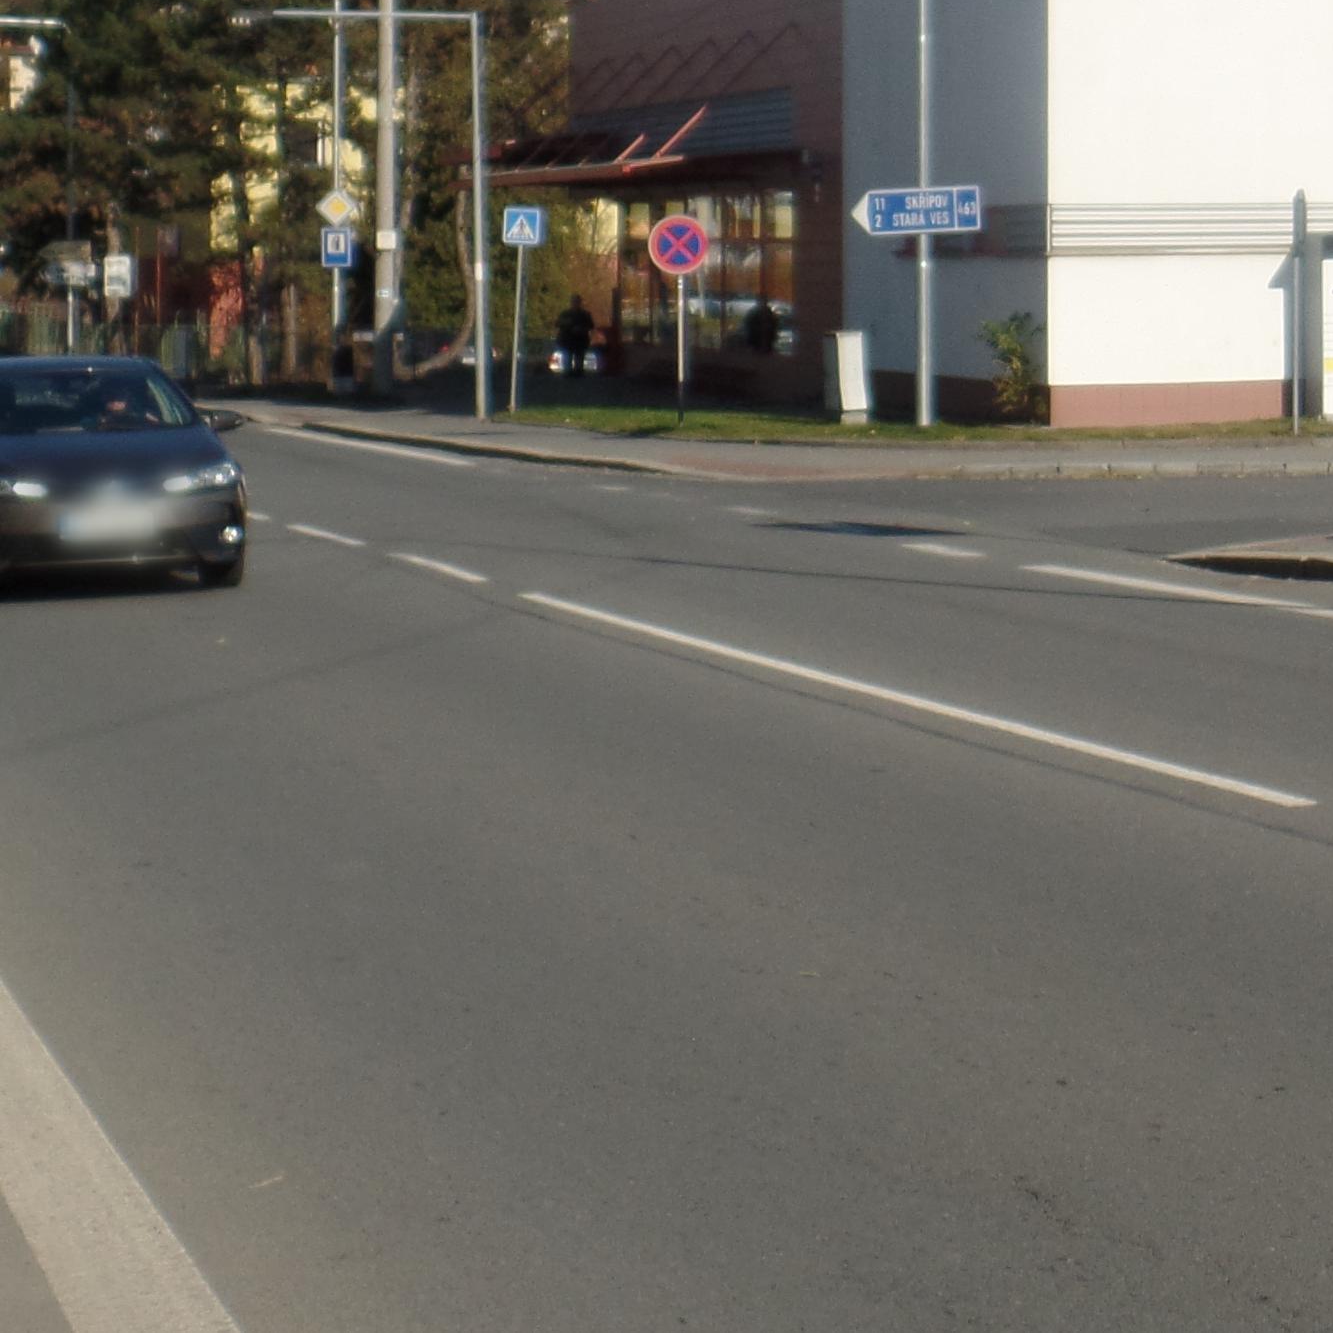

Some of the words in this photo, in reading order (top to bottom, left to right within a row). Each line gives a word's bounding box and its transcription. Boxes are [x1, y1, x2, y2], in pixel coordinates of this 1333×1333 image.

[874, 197, 886, 210] 11
[874, 214, 882, 227] 2
[892, 210, 926, 227] STARÁ
[929, 211, 949, 225] VES
